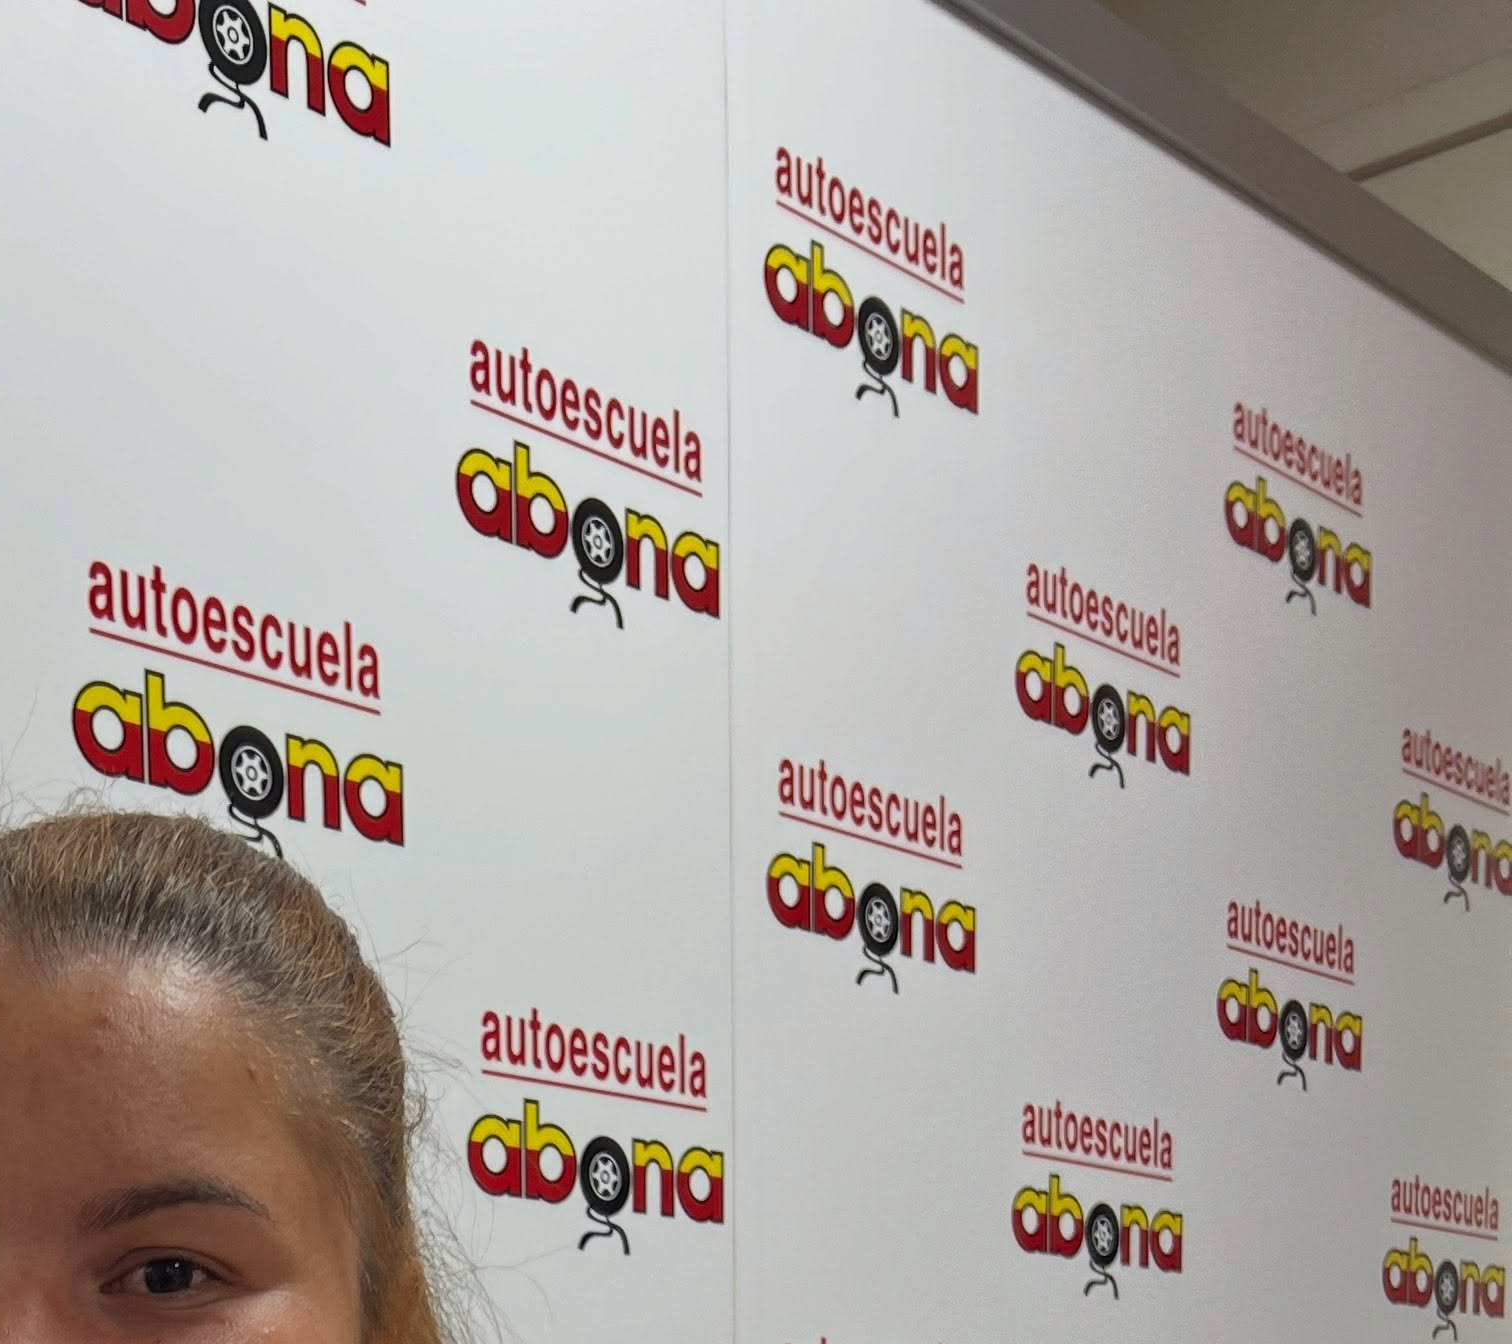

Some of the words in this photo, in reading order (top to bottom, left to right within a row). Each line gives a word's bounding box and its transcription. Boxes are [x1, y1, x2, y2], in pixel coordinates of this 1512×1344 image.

[776, 146, 965, 291] autoescuela
[763, 239, 979, 415] abona
[469, 339, 703, 483] autoescuela
[1232, 402, 1363, 505] autoescuela
[456, 440, 721, 620] abona
[1224, 476, 1373, 609] abona
[88, 560, 380, 699] autoescuela
[1026, 562, 1181, 667] autoescuela
[72, 669, 405, 846] abona
[1015, 642, 1191, 777] abona
[777, 758, 963, 856] autoescuela
[1402, 728, 1510, 805] autoescuela
[766, 841, 977, 974] abona
[1227, 900, 1355, 974] autoescuela
[481, 1008, 707, 1099] autoescuela
[1217, 968, 1363, 1072] abona
[467, 1098, 725, 1225] abona
[1021, 1100, 1173, 1170] autoescuela
[1011, 1173, 1183, 1274] abona
[1391, 1174, 1500, 1231] autoescuela
[1381, 1237, 1506, 1319] abona
